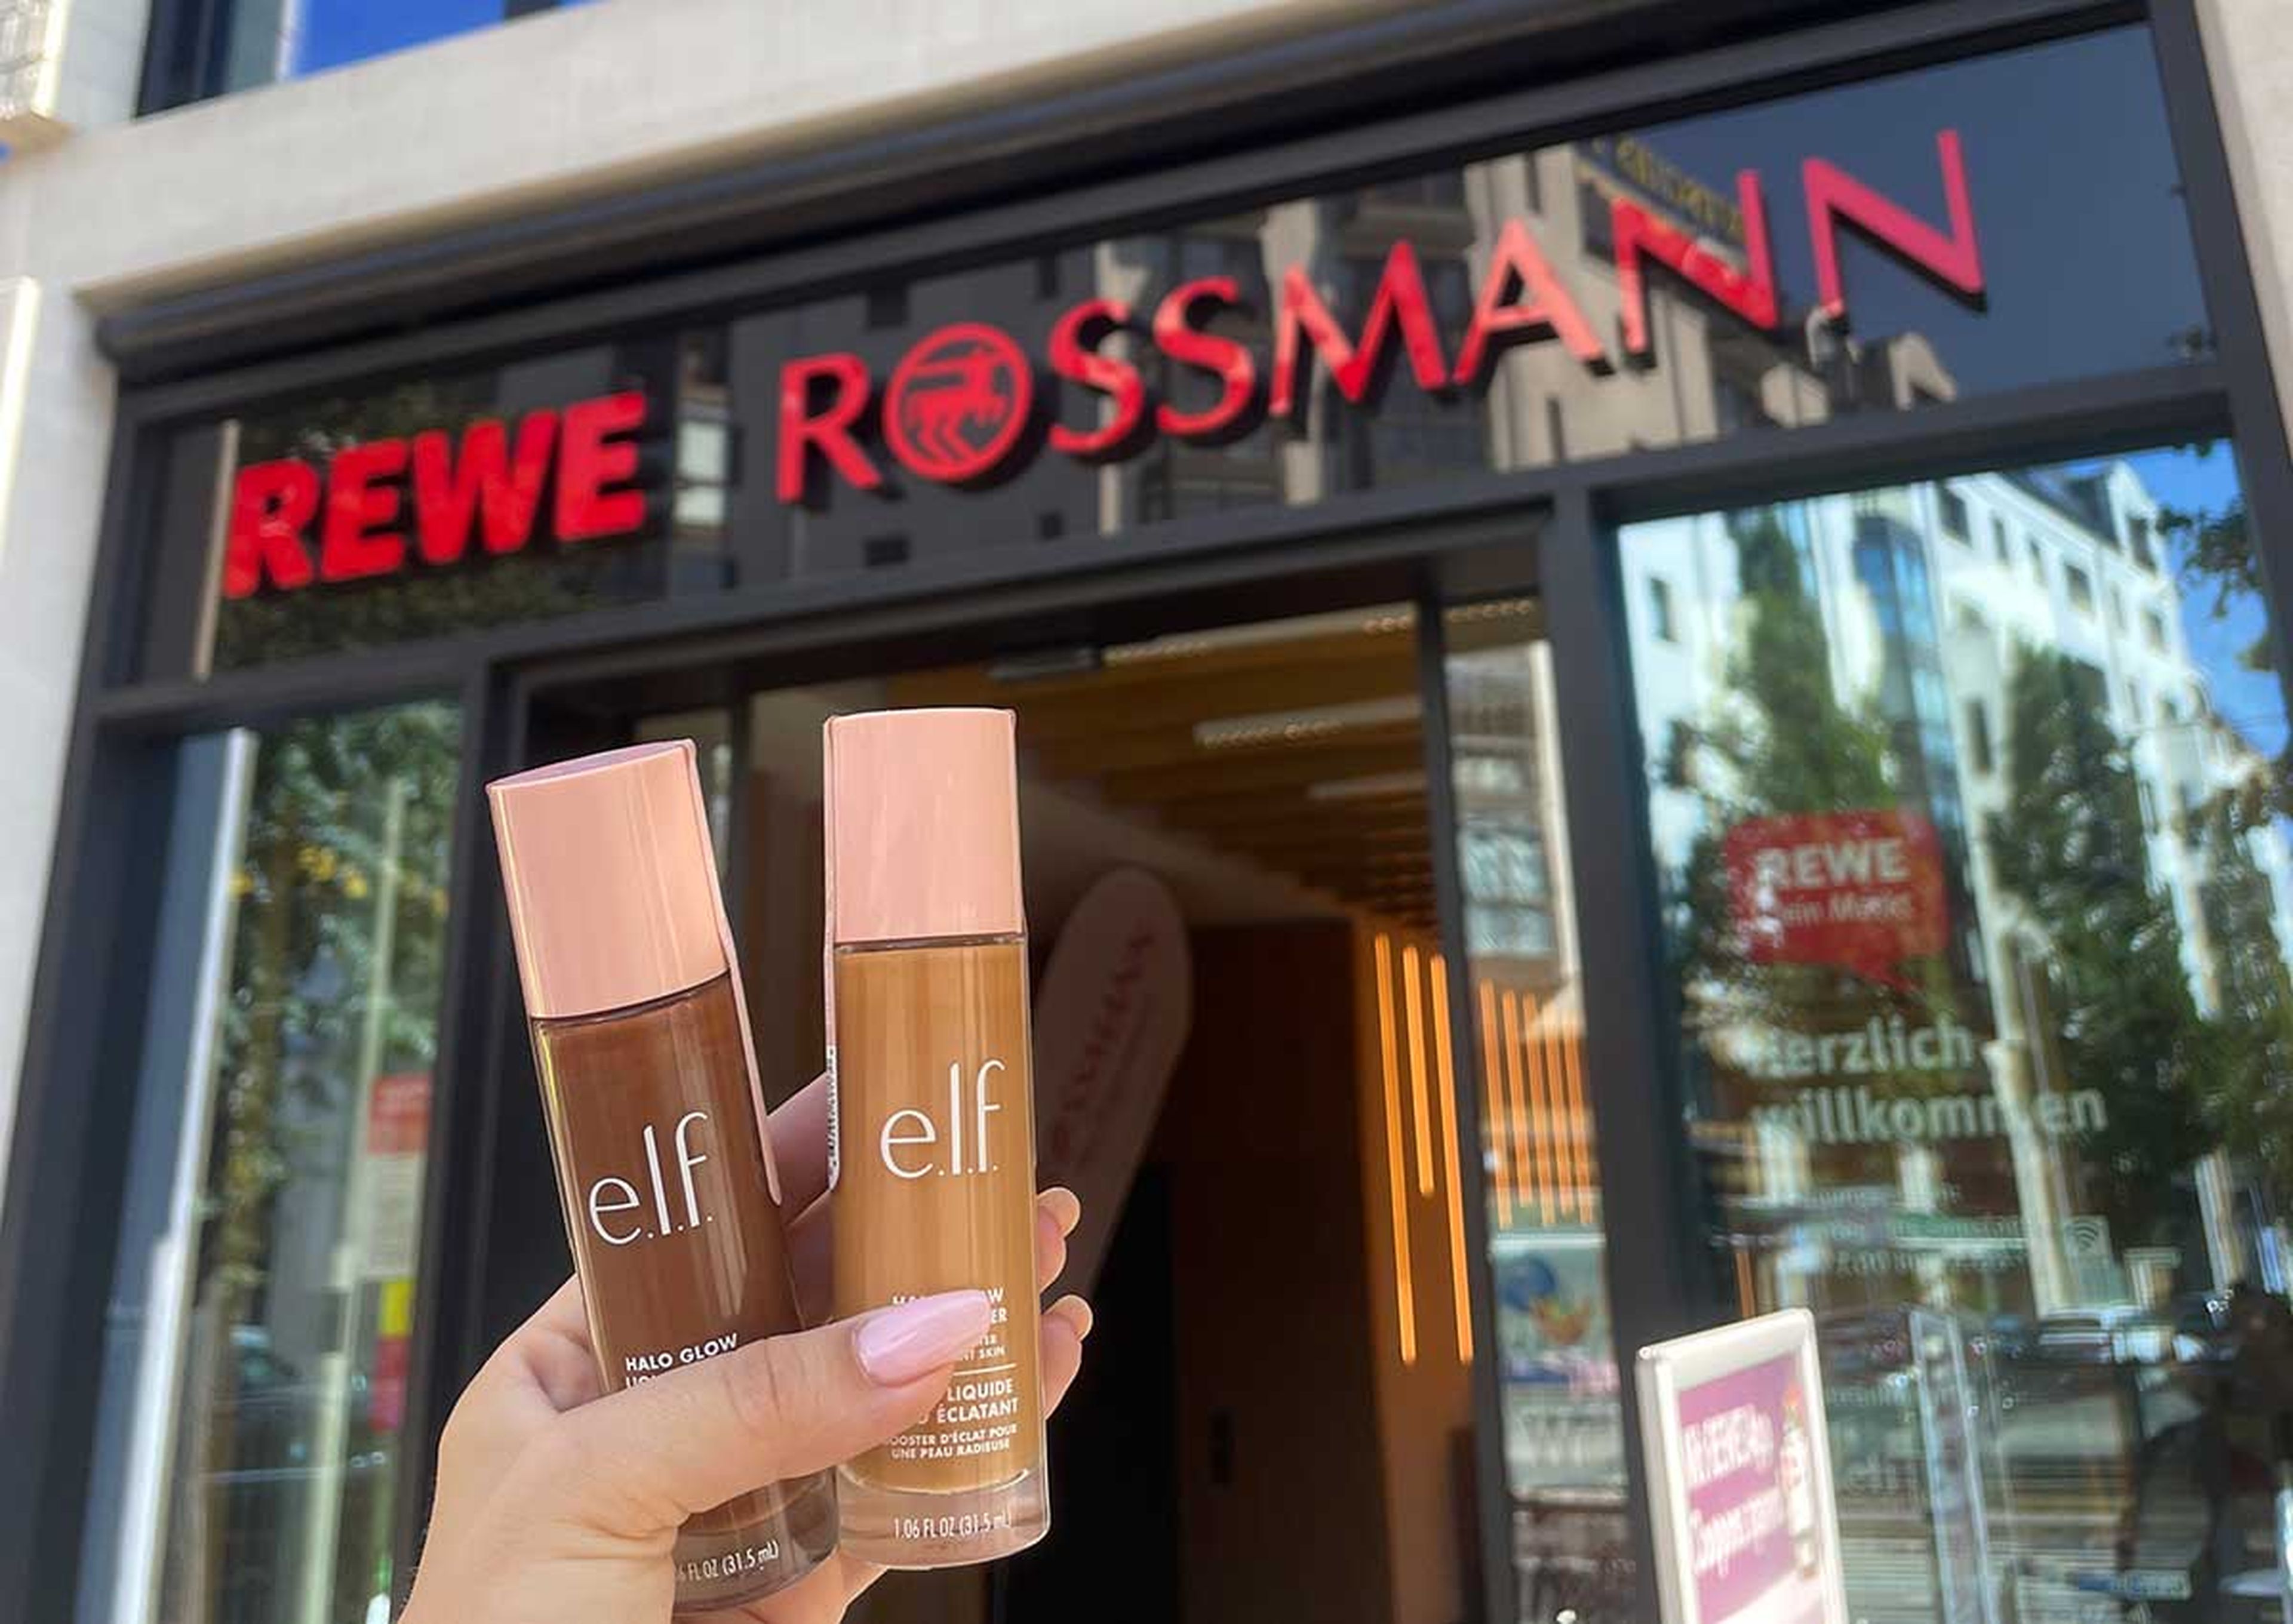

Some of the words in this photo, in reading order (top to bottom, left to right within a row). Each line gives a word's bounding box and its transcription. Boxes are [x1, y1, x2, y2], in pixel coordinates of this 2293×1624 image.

[776, 130, 1985, 502] ROSSMANN
[222, 391, 646, 598] REWE
[1754, 838, 1910, 887] REWE
[1753, 1015, 1973, 1077] erzlich
[625, 1352, 674, 1371] HALO
[679, 1332, 738, 1363] GLOW
[979, 1346, 1006, 1360] SKIN
[946, 1378, 1013, 1402] LIQUIDE
[936, 1397, 1019, 1424] ÉCLATANT
[889, 1435, 936, 1447] OOSTER
[920, 1445, 953, 1459] PEAU
[894, 1517, 920, 1539] 1.06
[923, 1518, 937, 1538] FL
[939, 1516, 955, 1537] OZ
[959, 1512, 992, 1537] (31.5
[688, 1562, 702, 1582] FL
[702, 1558, 720, 1579] OZ
[722, 1548, 757, 1576] (31.5
